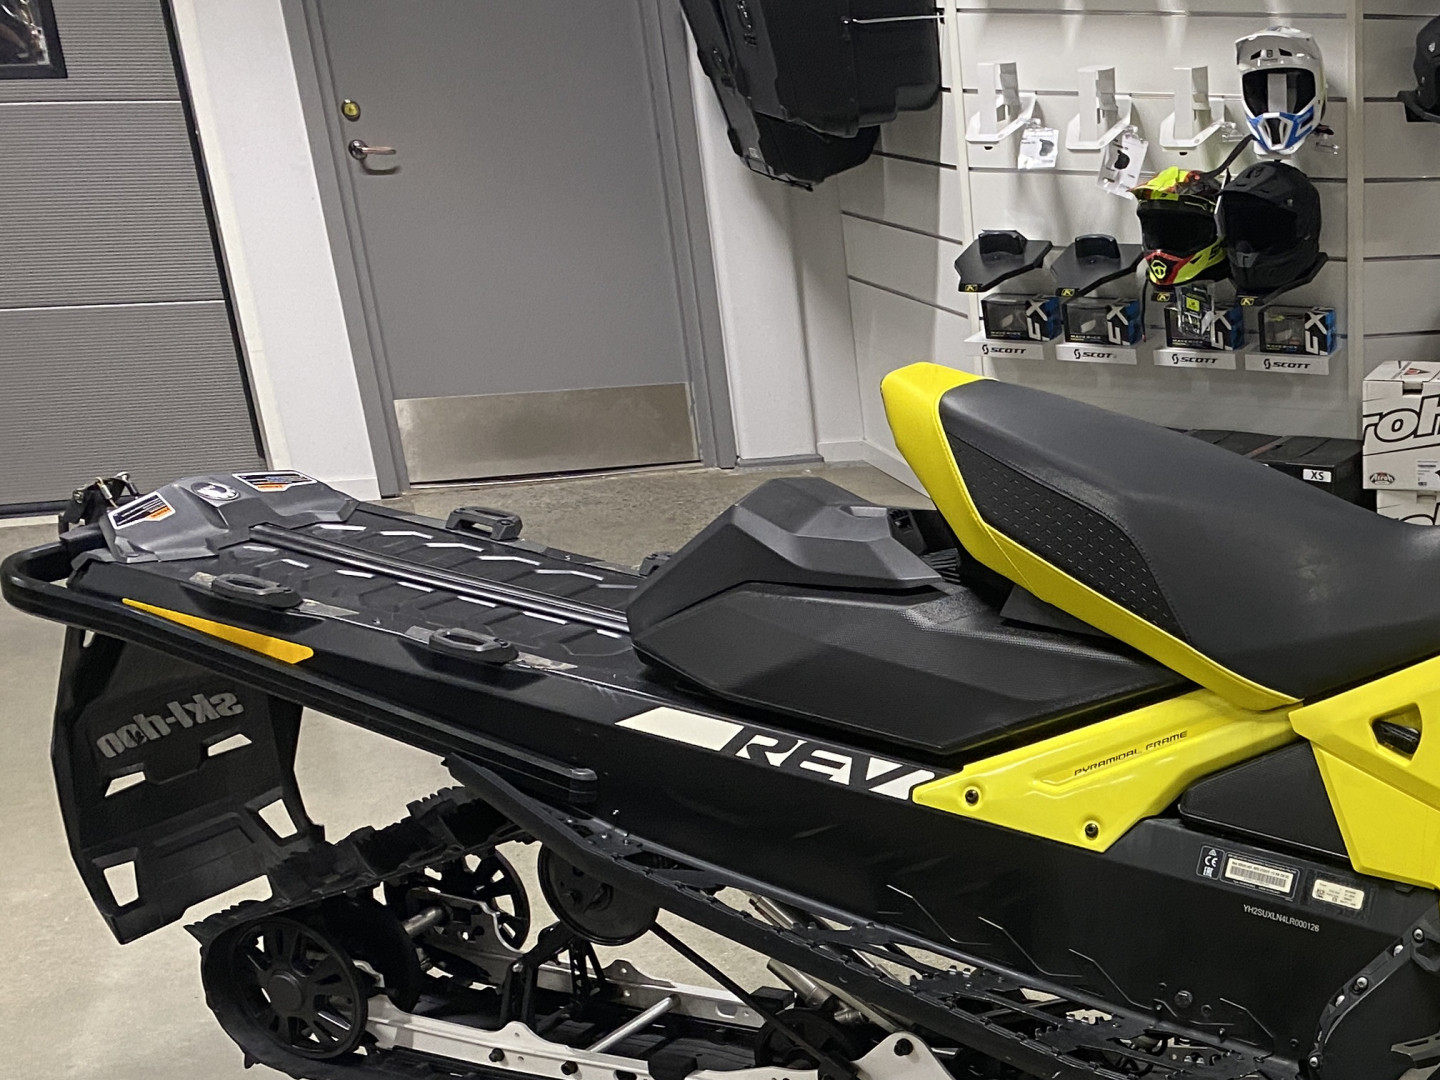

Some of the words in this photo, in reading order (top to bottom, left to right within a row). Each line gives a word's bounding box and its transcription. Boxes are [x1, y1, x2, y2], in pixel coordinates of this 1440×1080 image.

[990, 347, 1027, 355] SCOTT
[1180, 356, 1218, 364] SCOTT
[1272, 361, 1312, 369] SCOTT
[1310, 470, 1325, 480] XS
[1074, 748, 1142, 776] PYRAMIDAL
[1145, 729, 1188, 751] FRAME
[737, 730, 930, 799] REV
